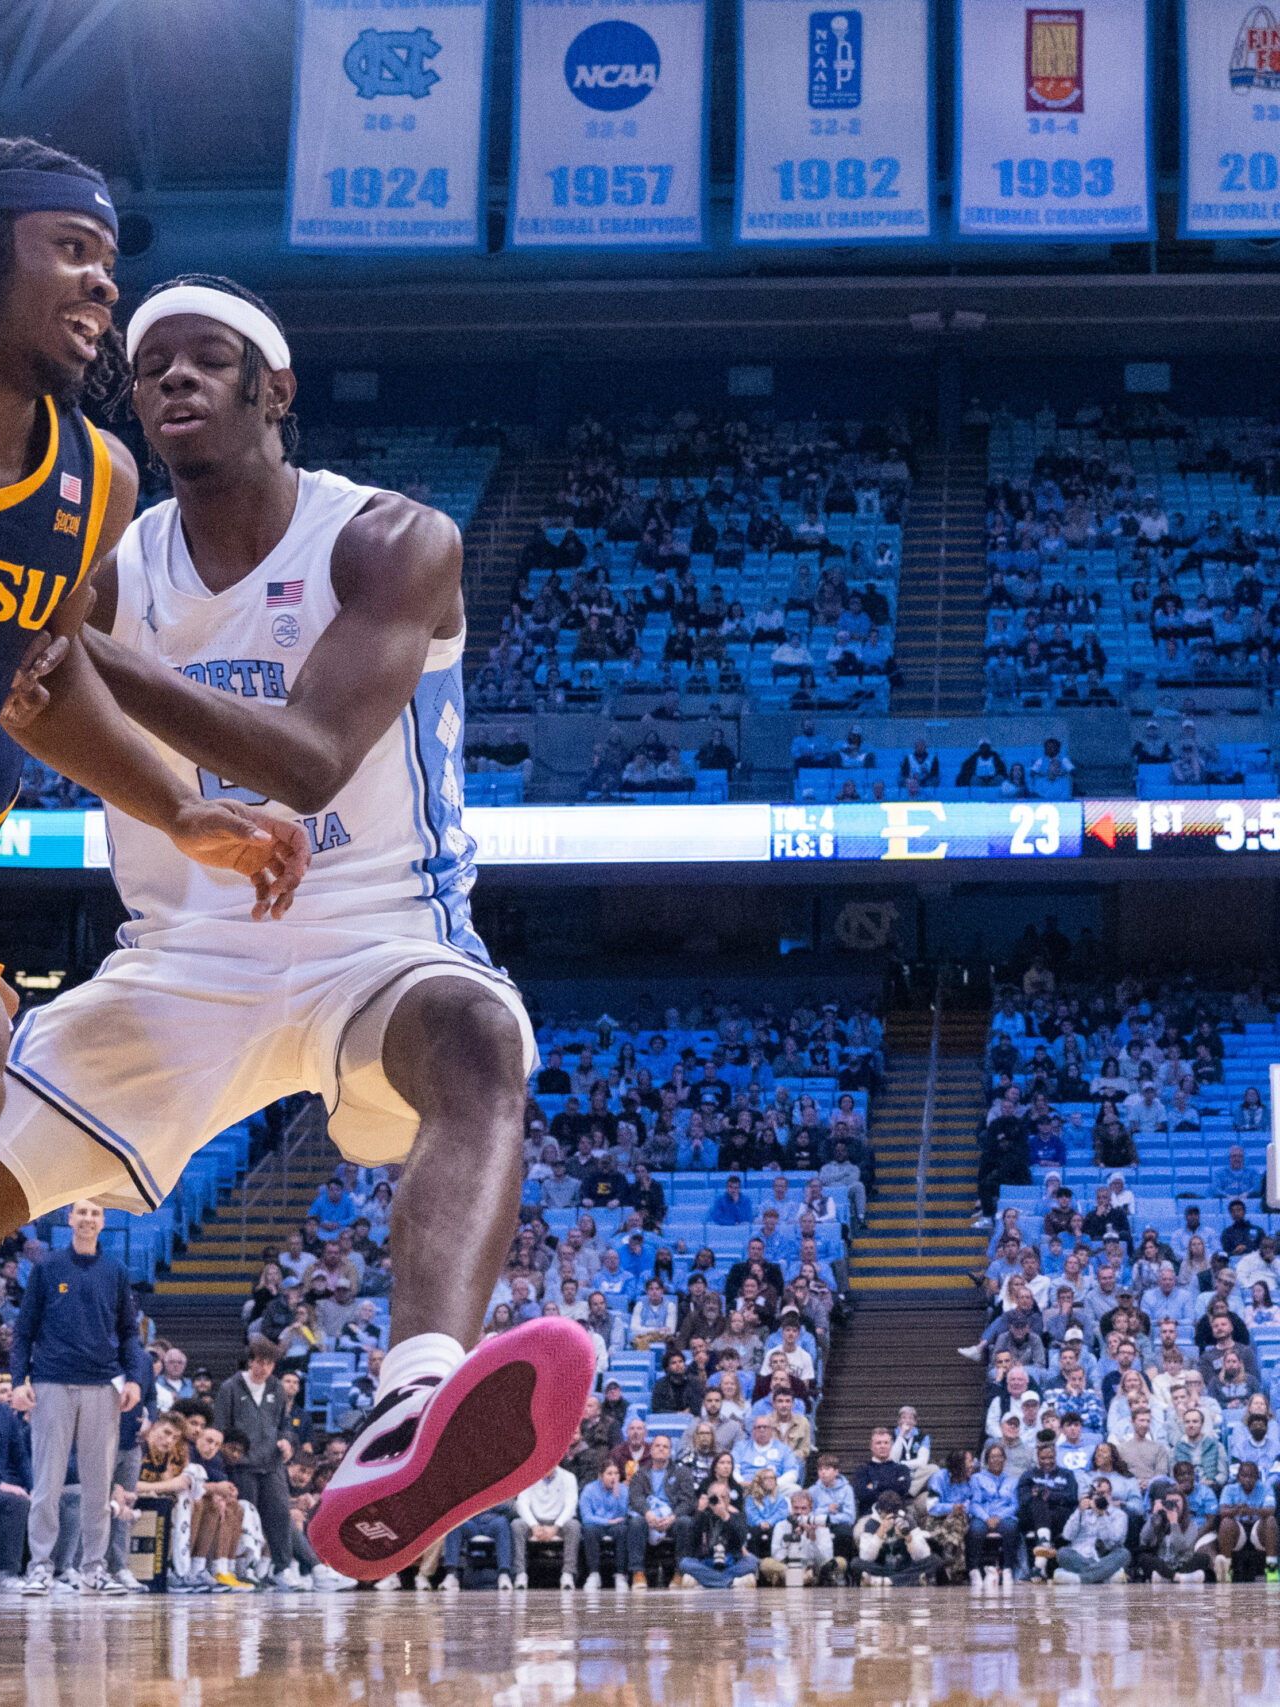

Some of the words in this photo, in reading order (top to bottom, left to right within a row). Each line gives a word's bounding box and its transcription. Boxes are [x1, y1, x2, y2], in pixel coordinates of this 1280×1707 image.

[573, 64, 657, 89] NCAA
[325, 166, 450, 210] 1924
[545, 164, 675, 207] 1957
[772, 157, 901, 202] 1982
[992, 157, 1115, 199] 1993
[746, 211, 825, 230] NATIONAL
[827, 208, 926, 228] CHAMPIONS
[964, 205, 1042, 224] NATIONAL
[1044, 204, 1143, 224] CHAMPIONS
[173, 659, 290, 699] ORTH
[819, 806, 835, 831] 4
[1009, 804, 1060, 855] 23
[1132, 802, 1185, 851] 1ST
[773, 833, 817, 858] FLS:
[819, 833, 835, 858] 6
